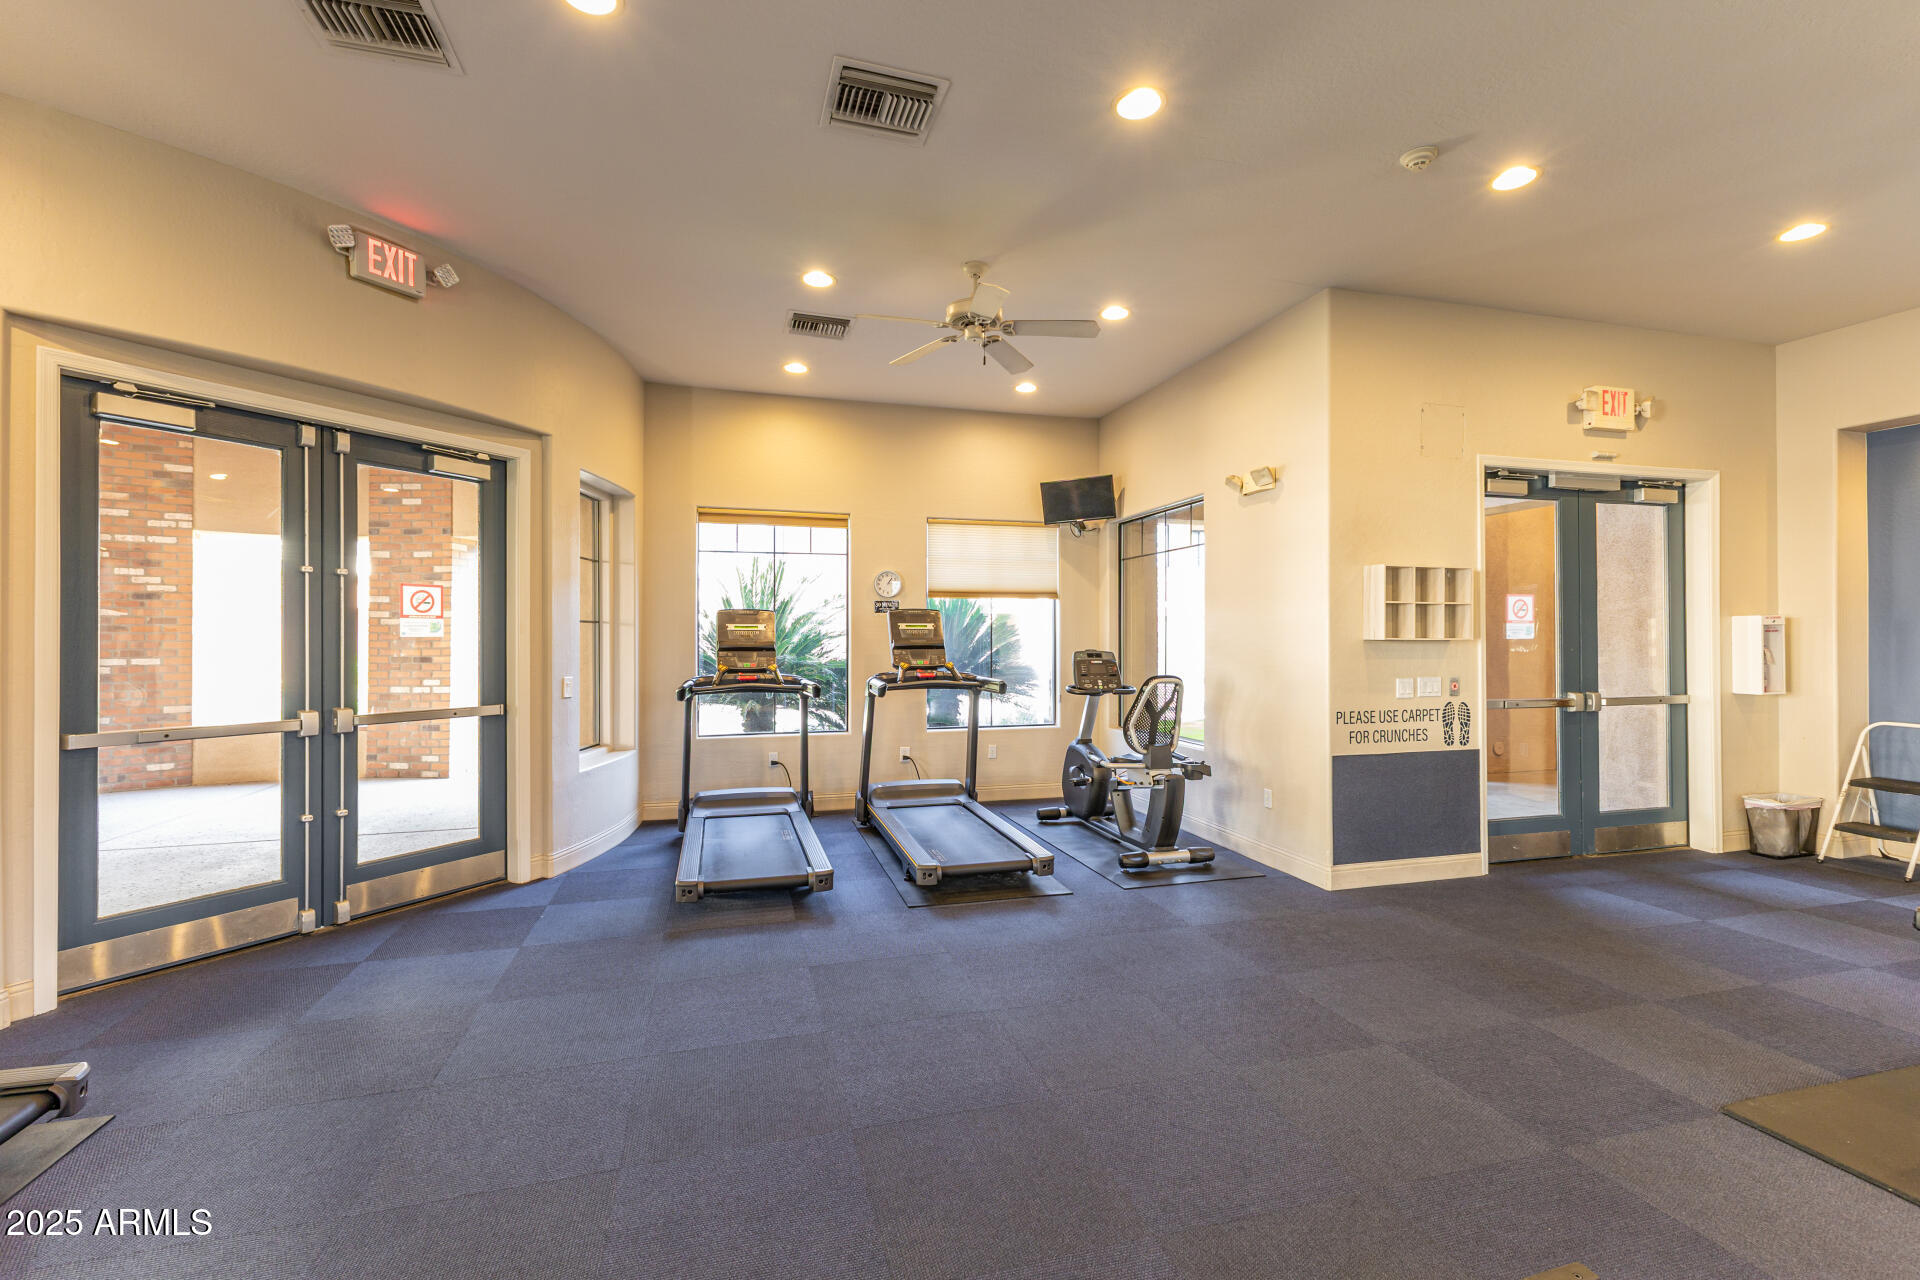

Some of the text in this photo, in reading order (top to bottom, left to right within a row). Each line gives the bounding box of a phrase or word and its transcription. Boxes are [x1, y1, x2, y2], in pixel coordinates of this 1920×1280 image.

[368, 237, 417, 288] EXIT
[1602, 389, 1628, 416] EXIT
[1336, 708, 1440, 725] PLEASE USE CARPET
[1349, 728, 1428, 744] FOR CRUNCHES
